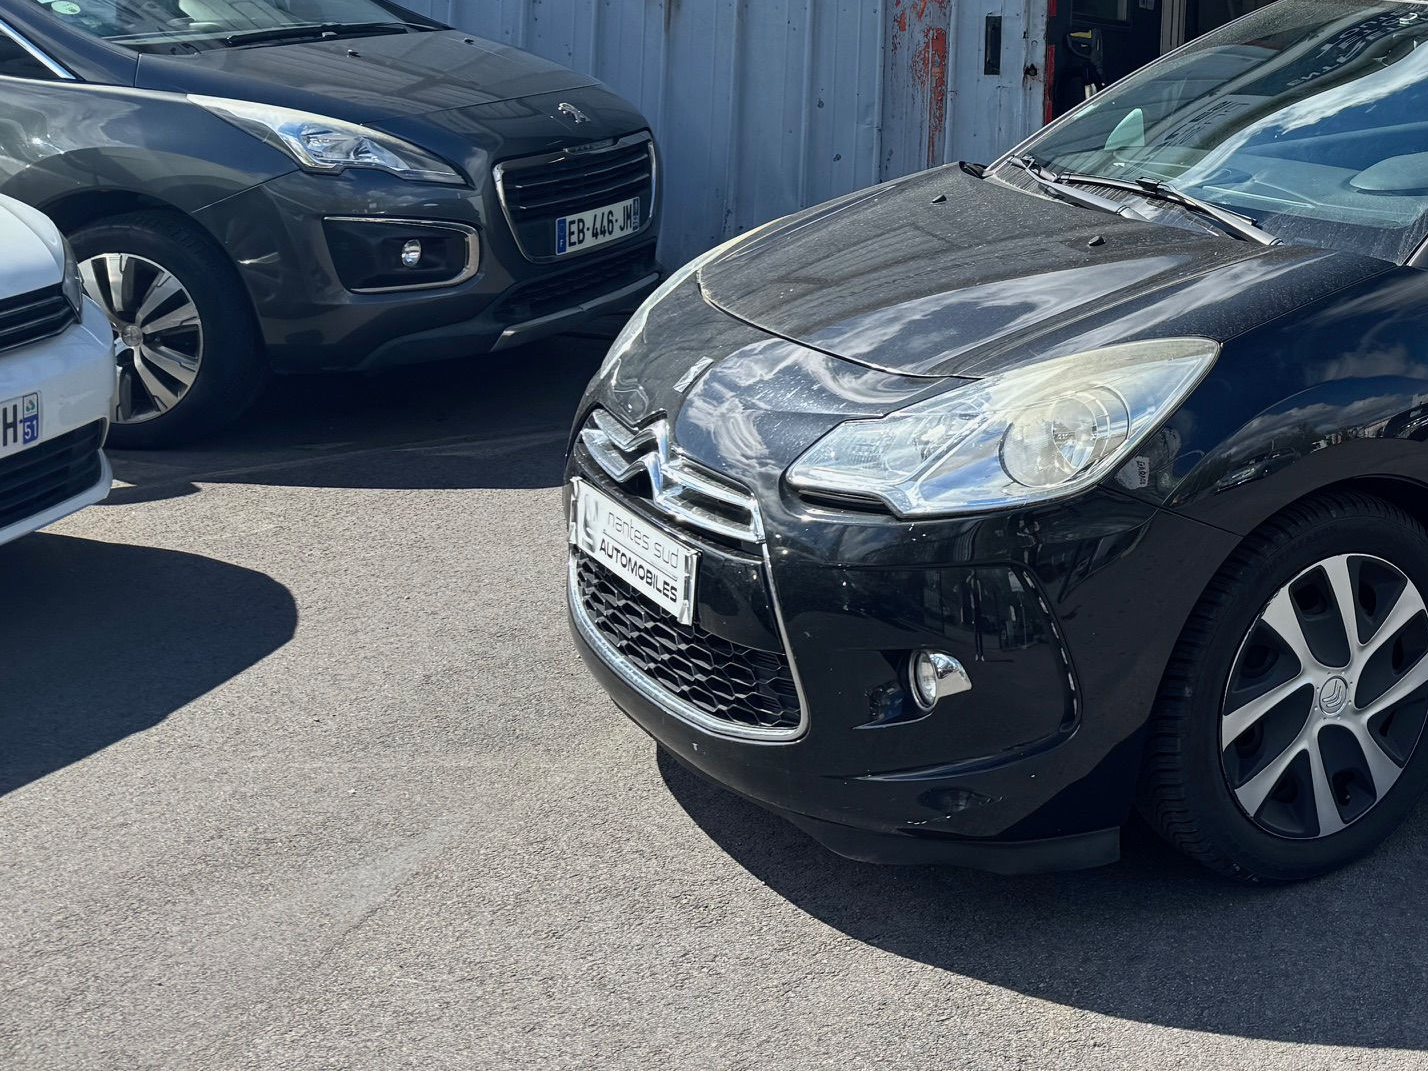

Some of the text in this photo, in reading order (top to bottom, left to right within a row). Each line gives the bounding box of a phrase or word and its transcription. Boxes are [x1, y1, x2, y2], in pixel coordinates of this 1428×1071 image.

[24, 420, 37, 440] 51
[608, 512, 679, 569] nantes sud
[600, 539, 677, 603] AUTOMOBILES
